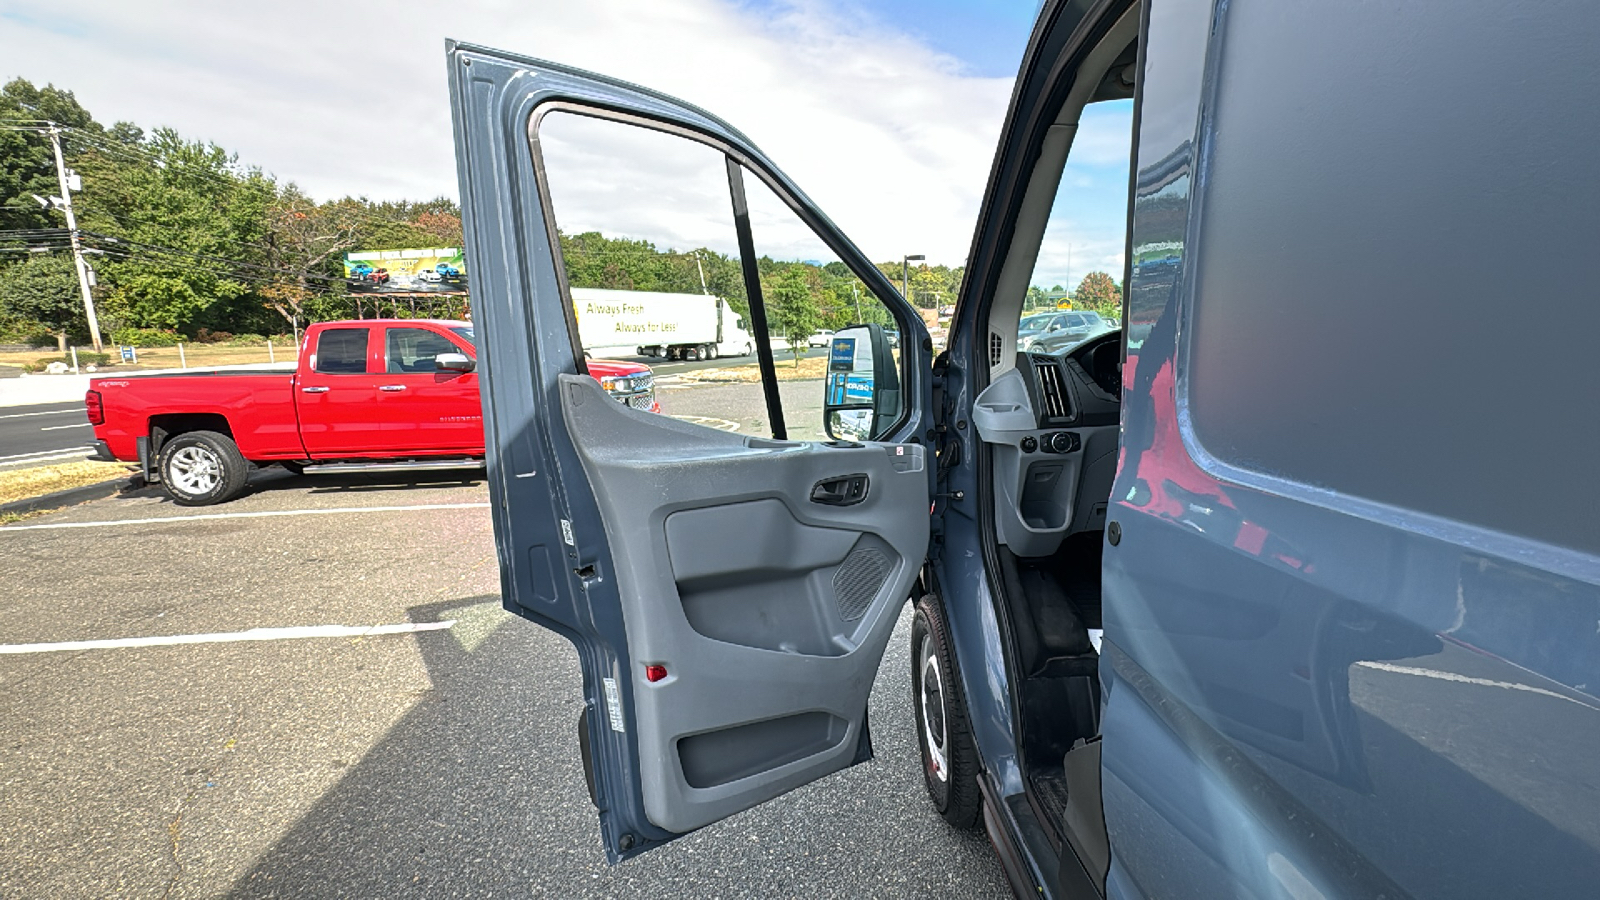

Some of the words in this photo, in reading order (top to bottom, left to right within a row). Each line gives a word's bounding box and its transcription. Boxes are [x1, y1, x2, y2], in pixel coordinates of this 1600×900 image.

[587, 303, 620, 317] Always
[623, 303, 644, 314] Fresh
[615, 322, 645, 334] Always
[648, 321, 659, 332] for
